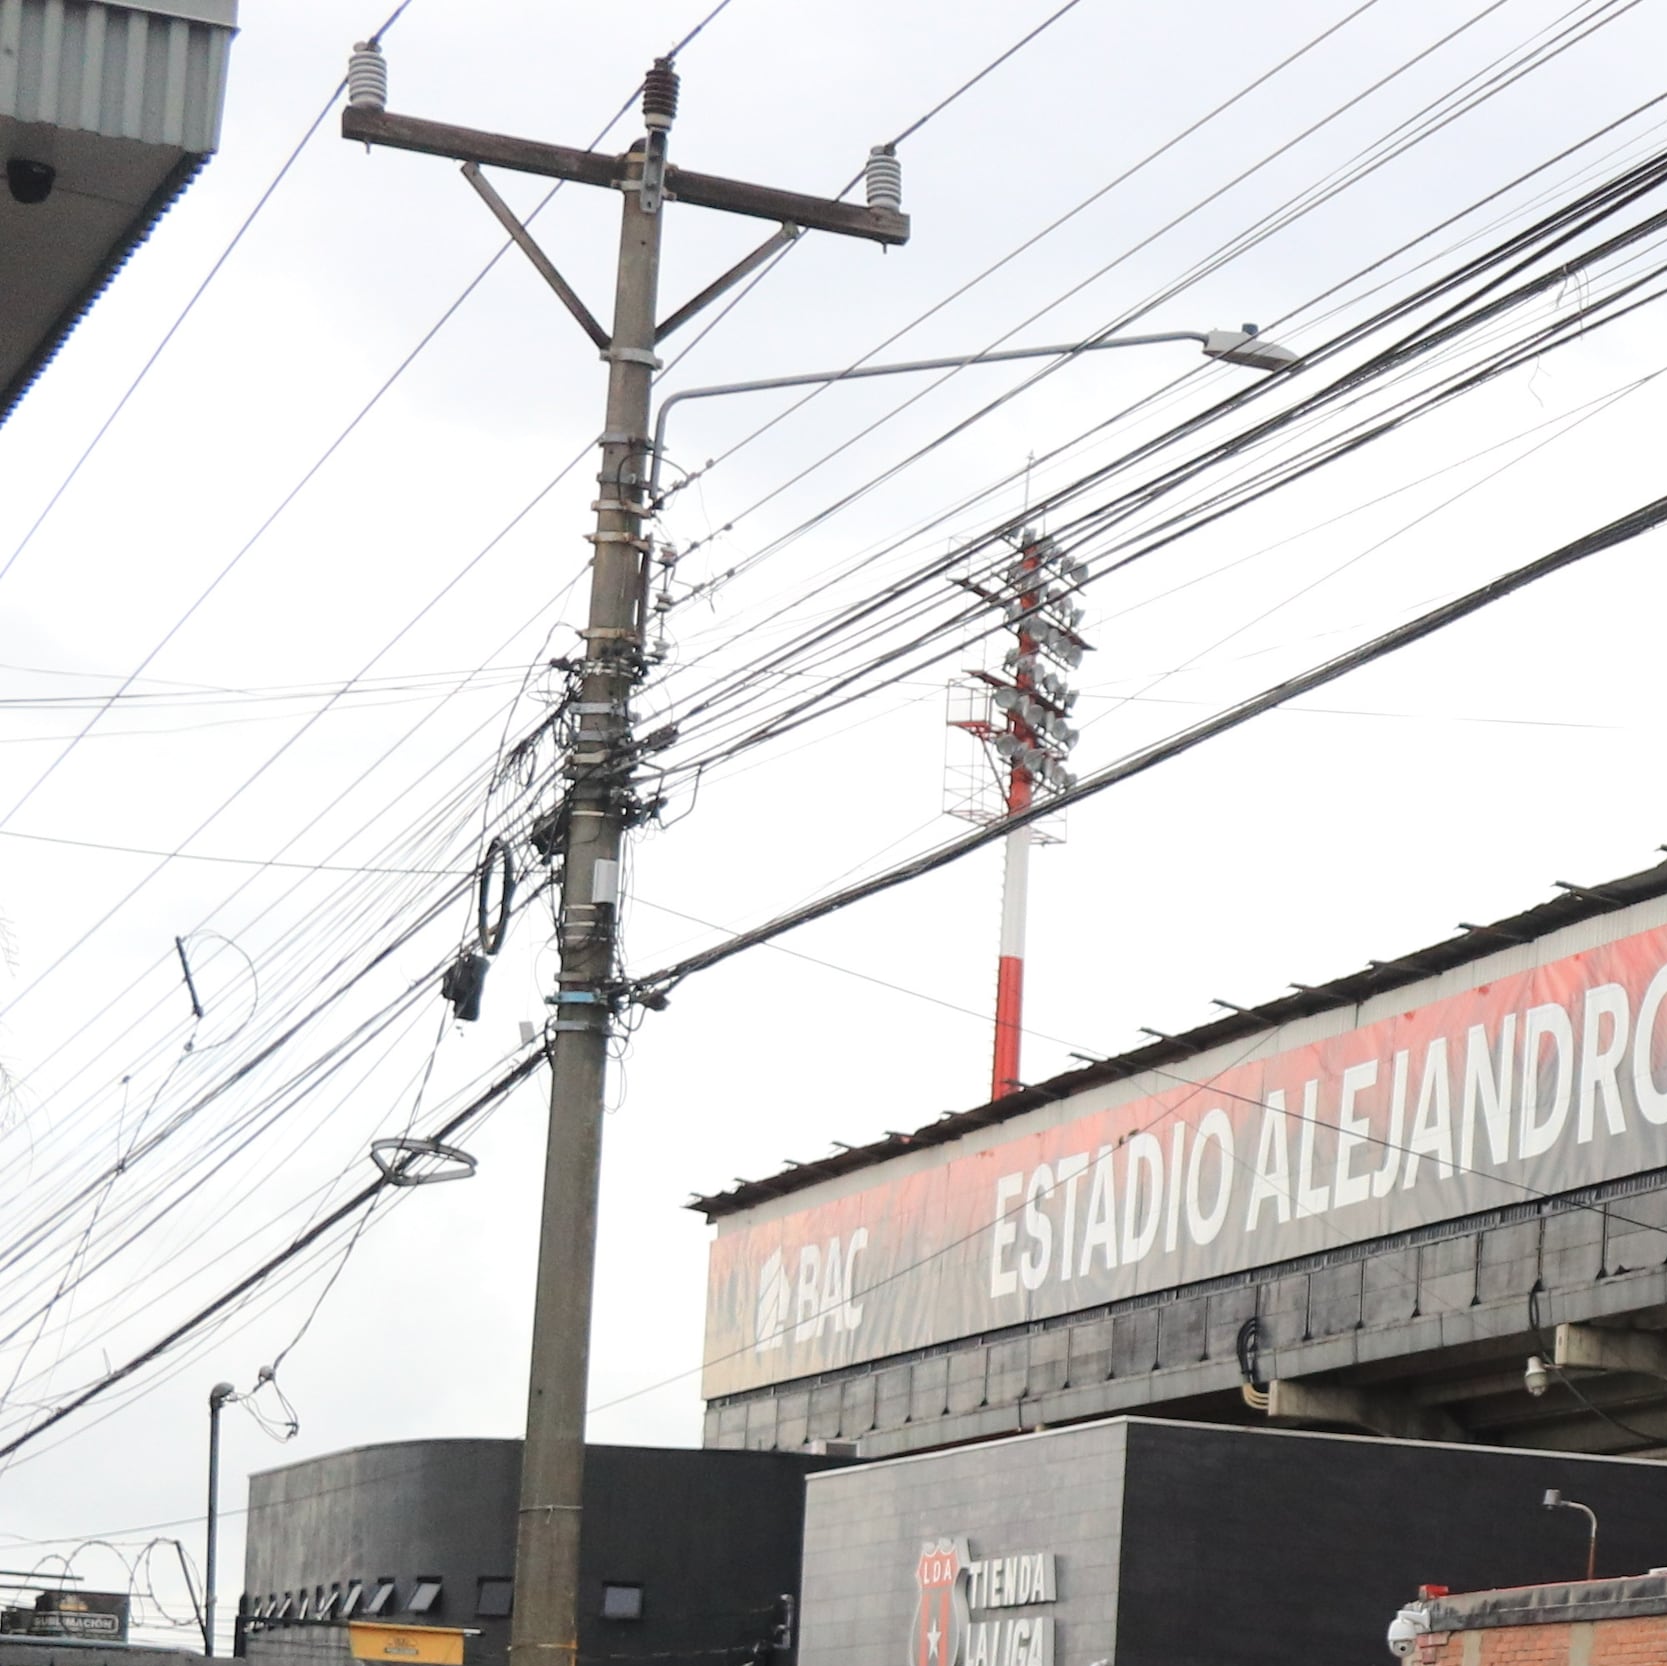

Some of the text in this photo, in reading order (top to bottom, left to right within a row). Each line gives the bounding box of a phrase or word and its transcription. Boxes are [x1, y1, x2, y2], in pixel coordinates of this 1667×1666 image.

[989, 1108, 1232, 1297] ESTADIO
[796, 1228, 868, 1342] BAC
[968, 1553, 1045, 1609] TIENDA
